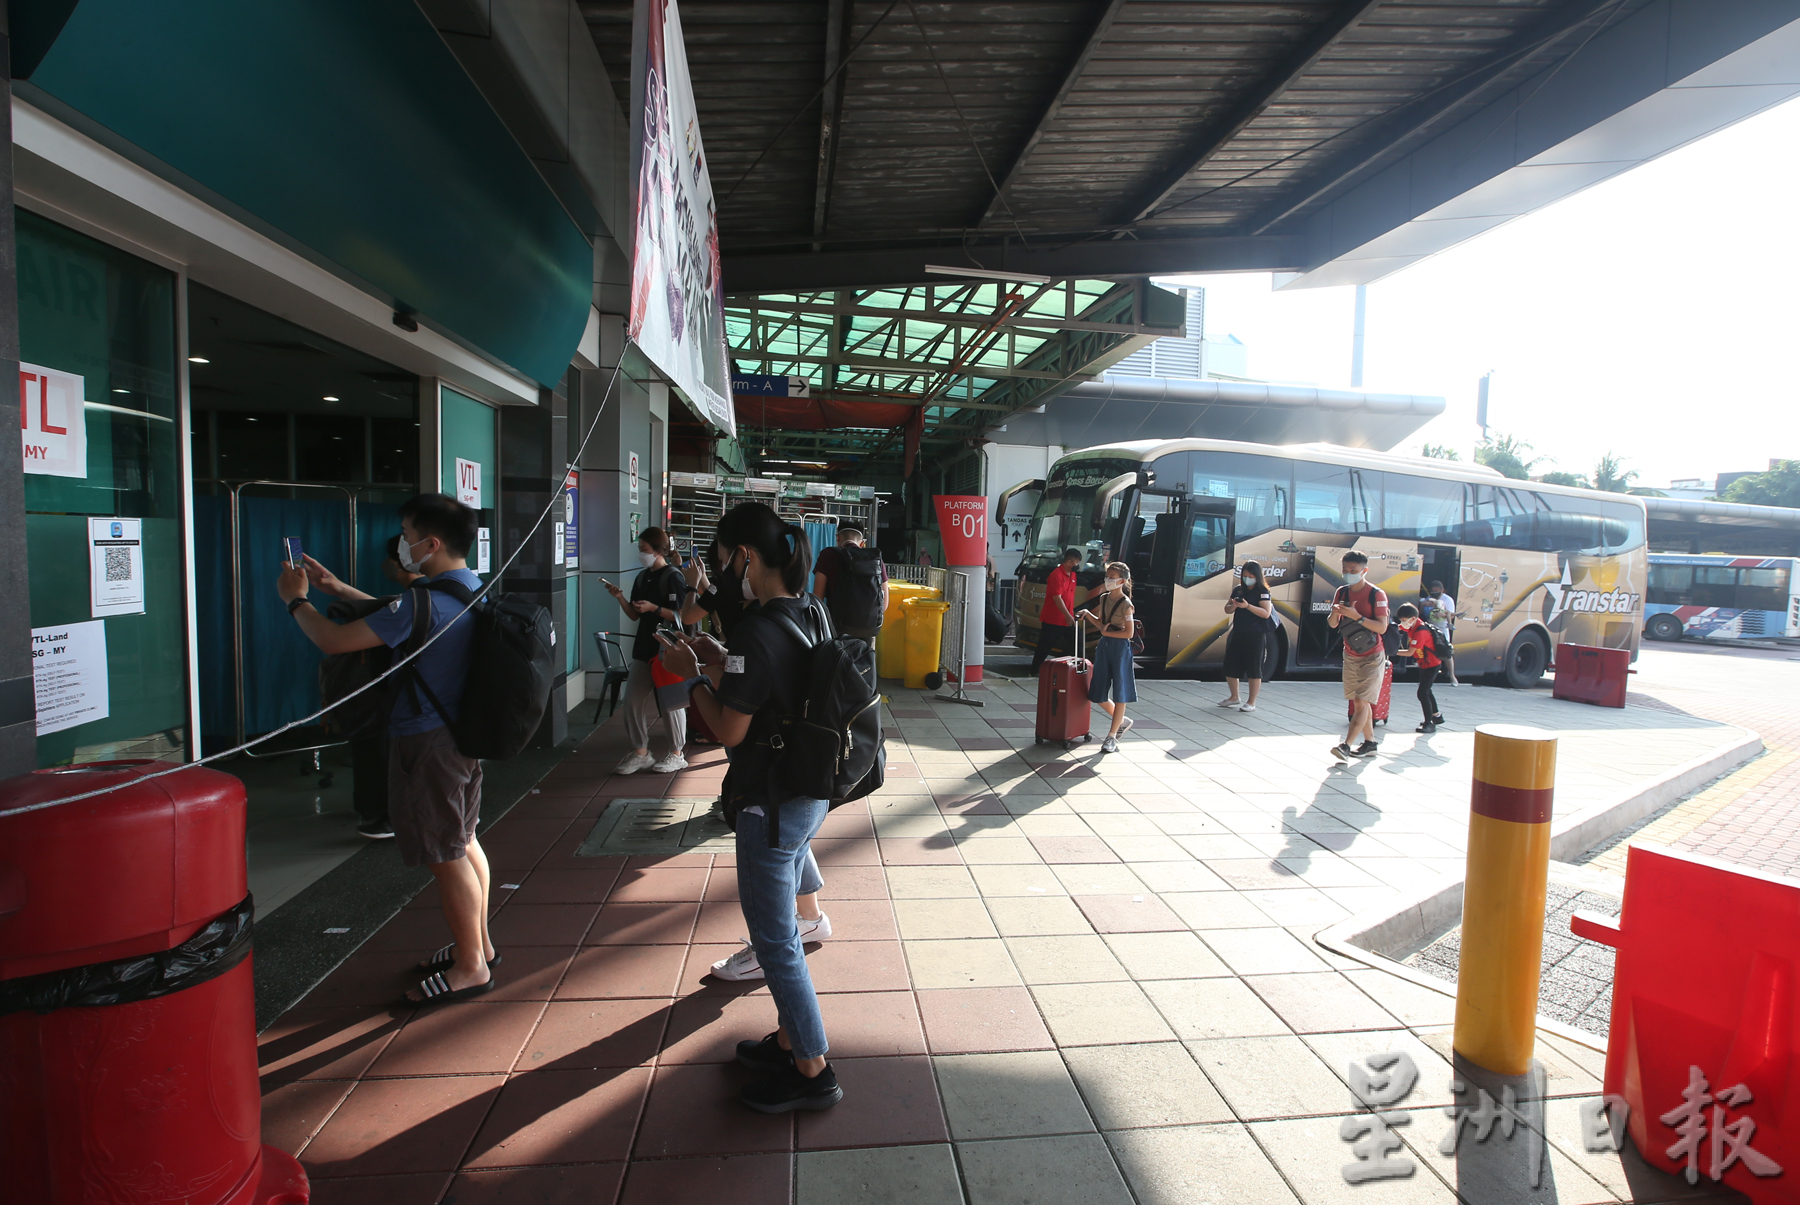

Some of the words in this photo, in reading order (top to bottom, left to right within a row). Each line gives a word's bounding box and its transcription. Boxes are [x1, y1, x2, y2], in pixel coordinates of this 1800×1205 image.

[762, 380, 772, 391] A
[24, 444, 48, 460] MY
[460, 462, 478, 491] VTL
[944, 501, 984, 510] PLATFORM
[1543, 559, 1640, 626] Transtar
[32, 650, 44, 658] SG
[53, 646, 66, 655] MY
